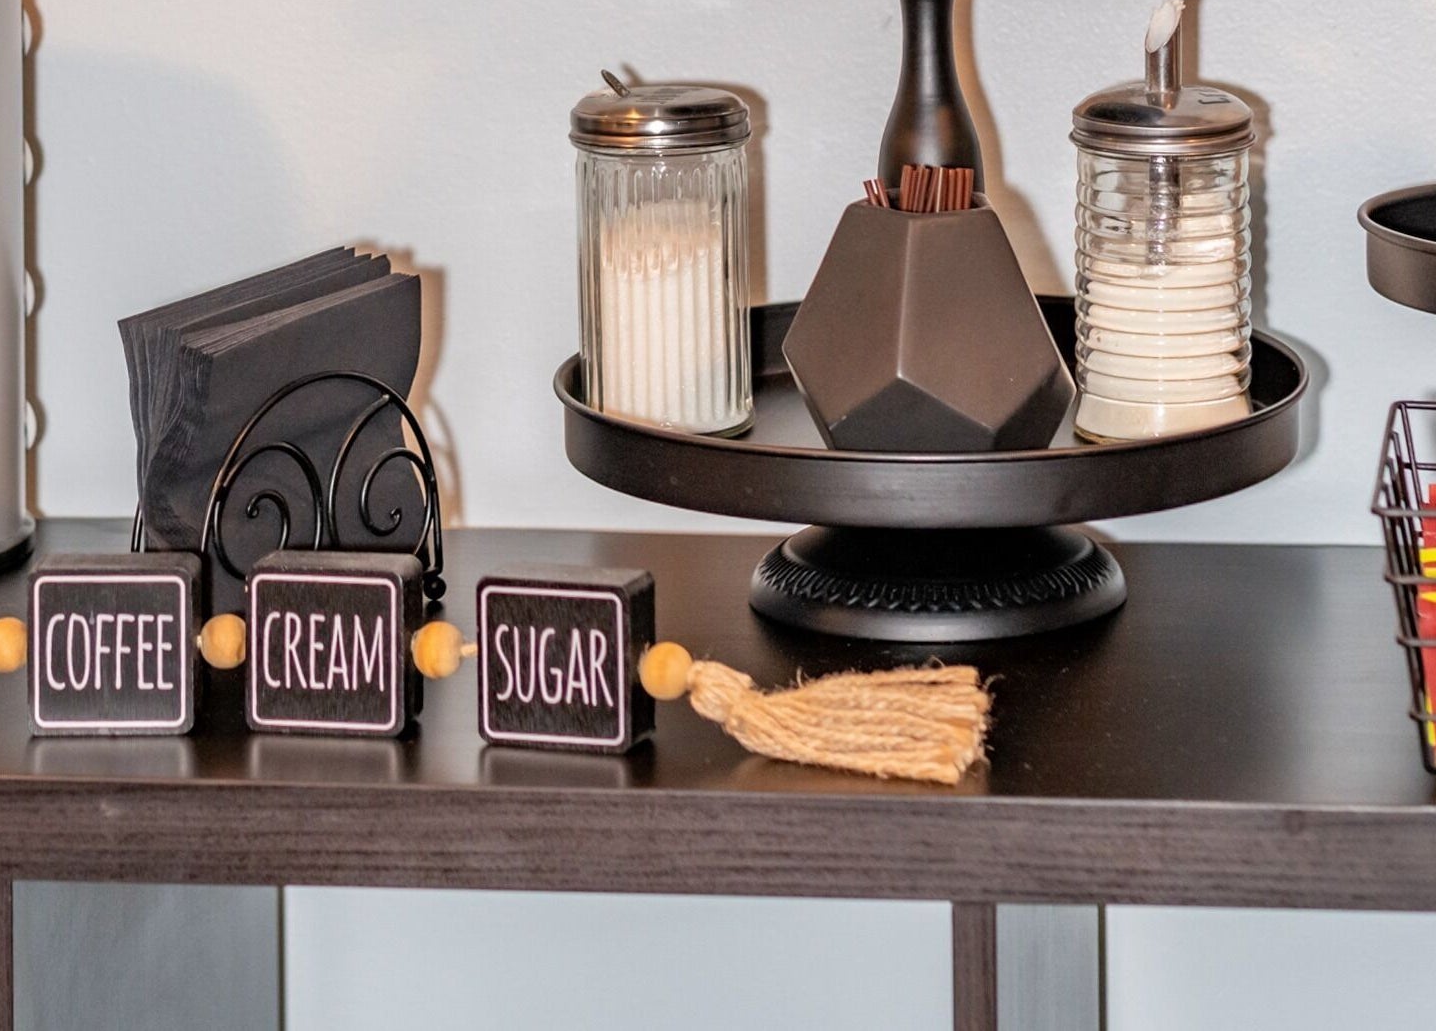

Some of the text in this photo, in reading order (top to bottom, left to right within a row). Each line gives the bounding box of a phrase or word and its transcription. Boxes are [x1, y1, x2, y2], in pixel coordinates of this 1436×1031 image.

[45, 612, 174, 691] COFFEE
[263, 611, 386, 692] CREAM
[495, 623, 614, 708] SUGAR
